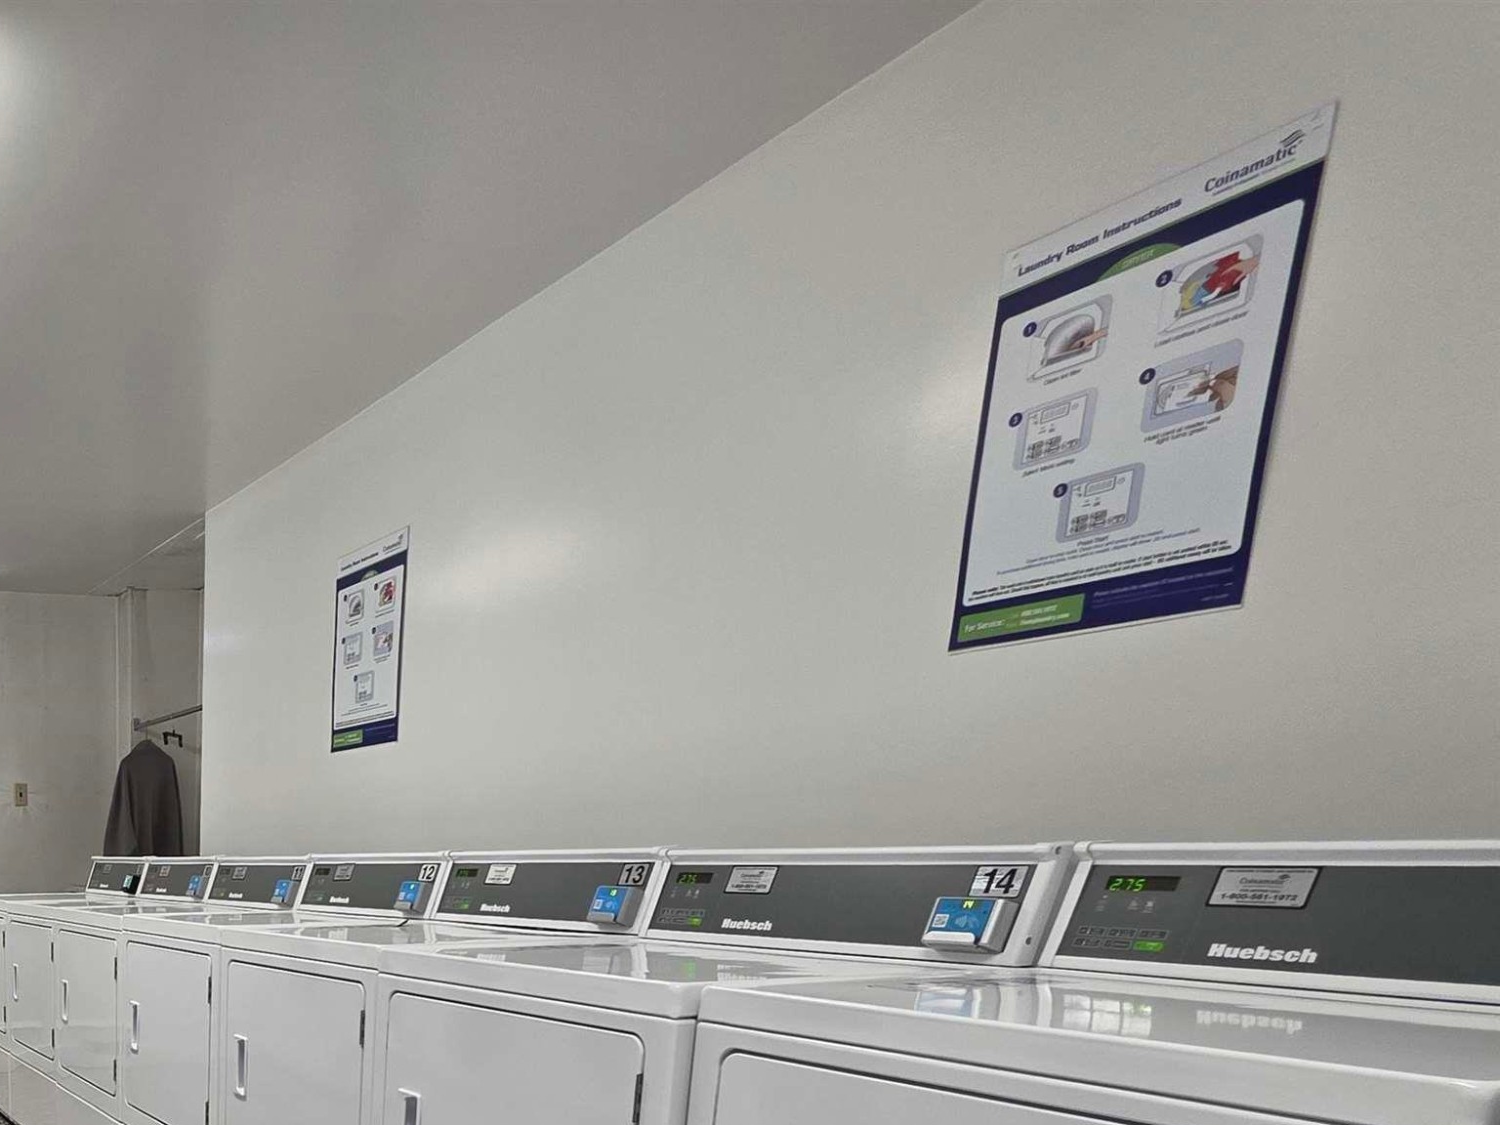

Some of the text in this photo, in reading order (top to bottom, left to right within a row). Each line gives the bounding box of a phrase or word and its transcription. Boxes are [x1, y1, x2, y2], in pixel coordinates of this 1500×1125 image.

[1204, 144, 1298, 192] Coinamatic
[1018, 198, 1182, 277] Laundry Room Instructions
[421, 866, 434, 880] 12
[625, 866, 645, 884] 13
[983, 868, 1018, 894] 14
[721, 918, 772, 931] Huebsch
[1207, 943, 1318, 963] Huebsch
